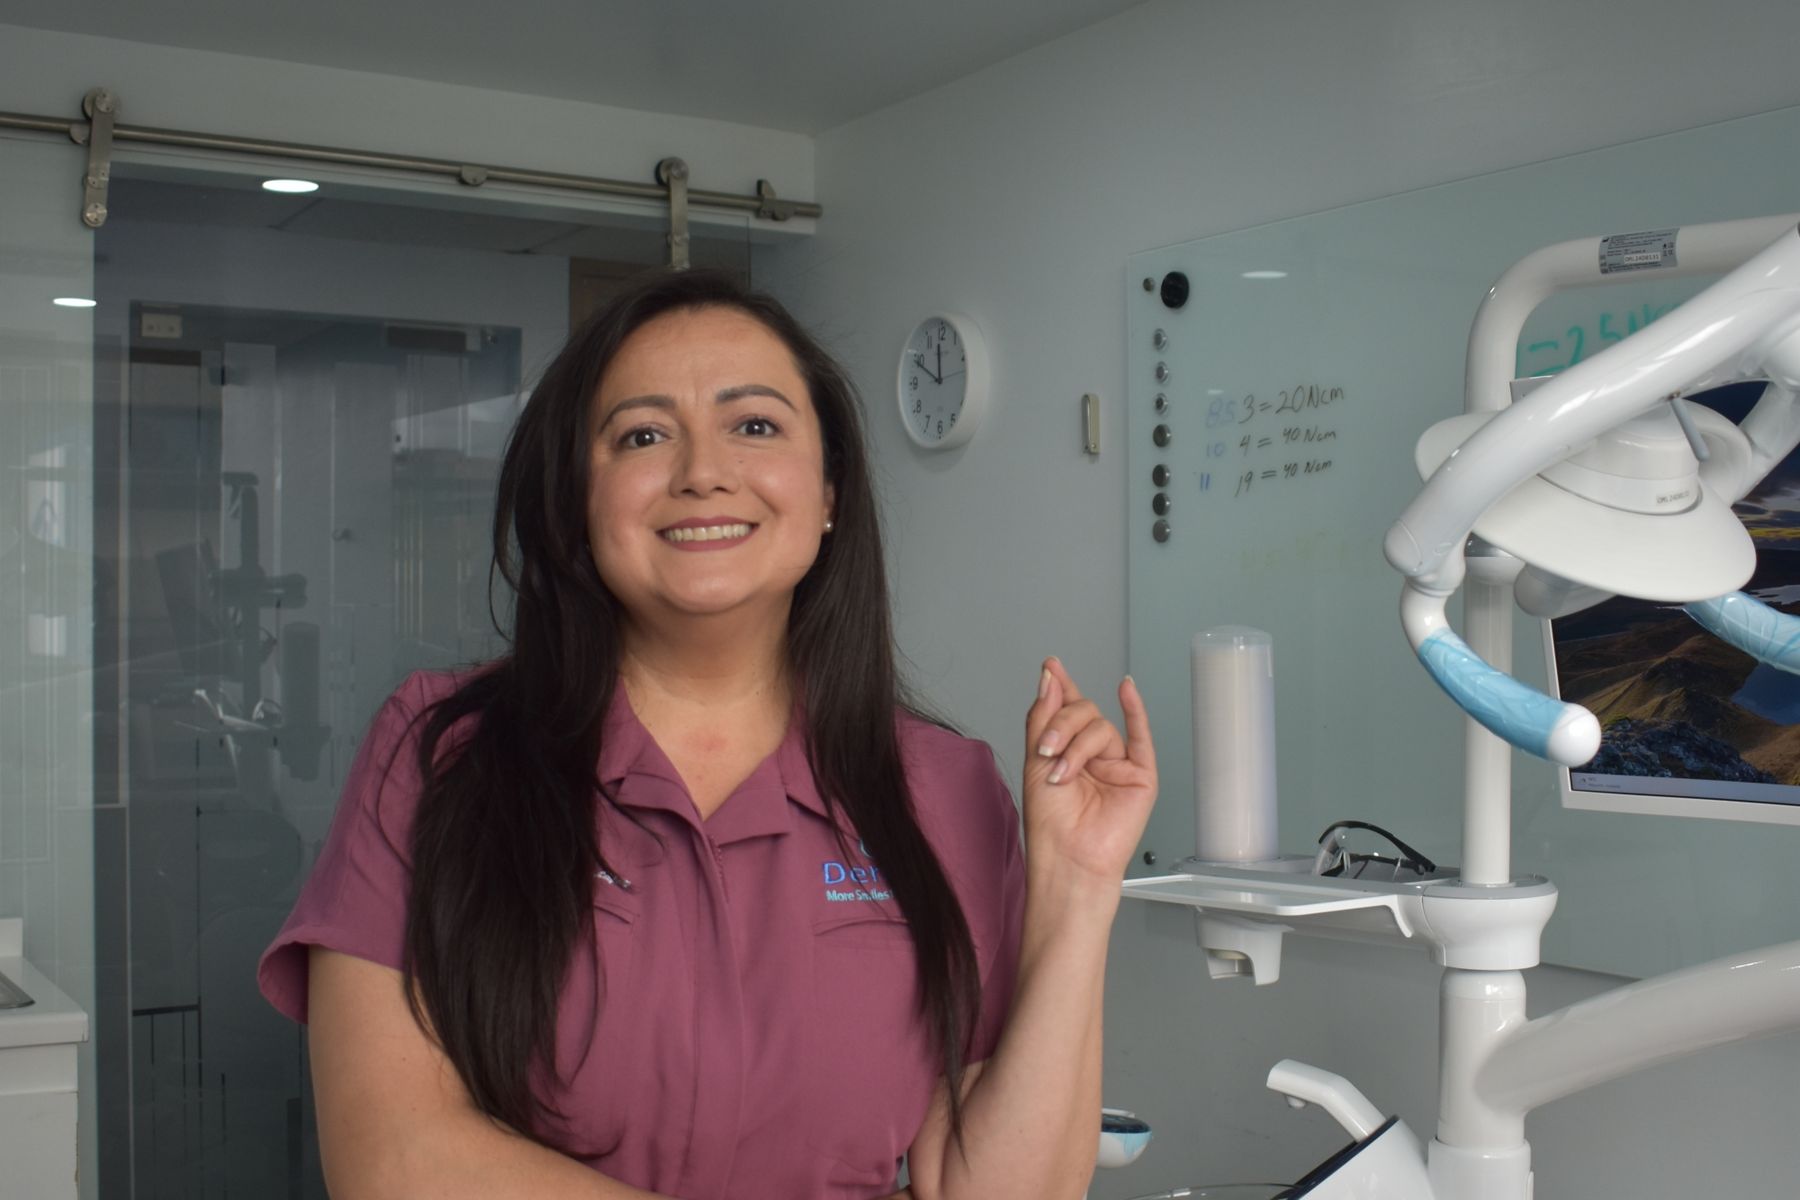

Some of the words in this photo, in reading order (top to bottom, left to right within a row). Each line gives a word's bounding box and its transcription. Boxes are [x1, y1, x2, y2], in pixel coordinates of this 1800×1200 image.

[937, 325, 947, 341] 12
[926, 335, 933, 350] 11
[912, 376, 919, 390] 9
[915, 399, 922, 413] 8
[925, 414, 931, 432] 7
[937, 420, 944, 434] 6
[826, 890, 855, 901] More
